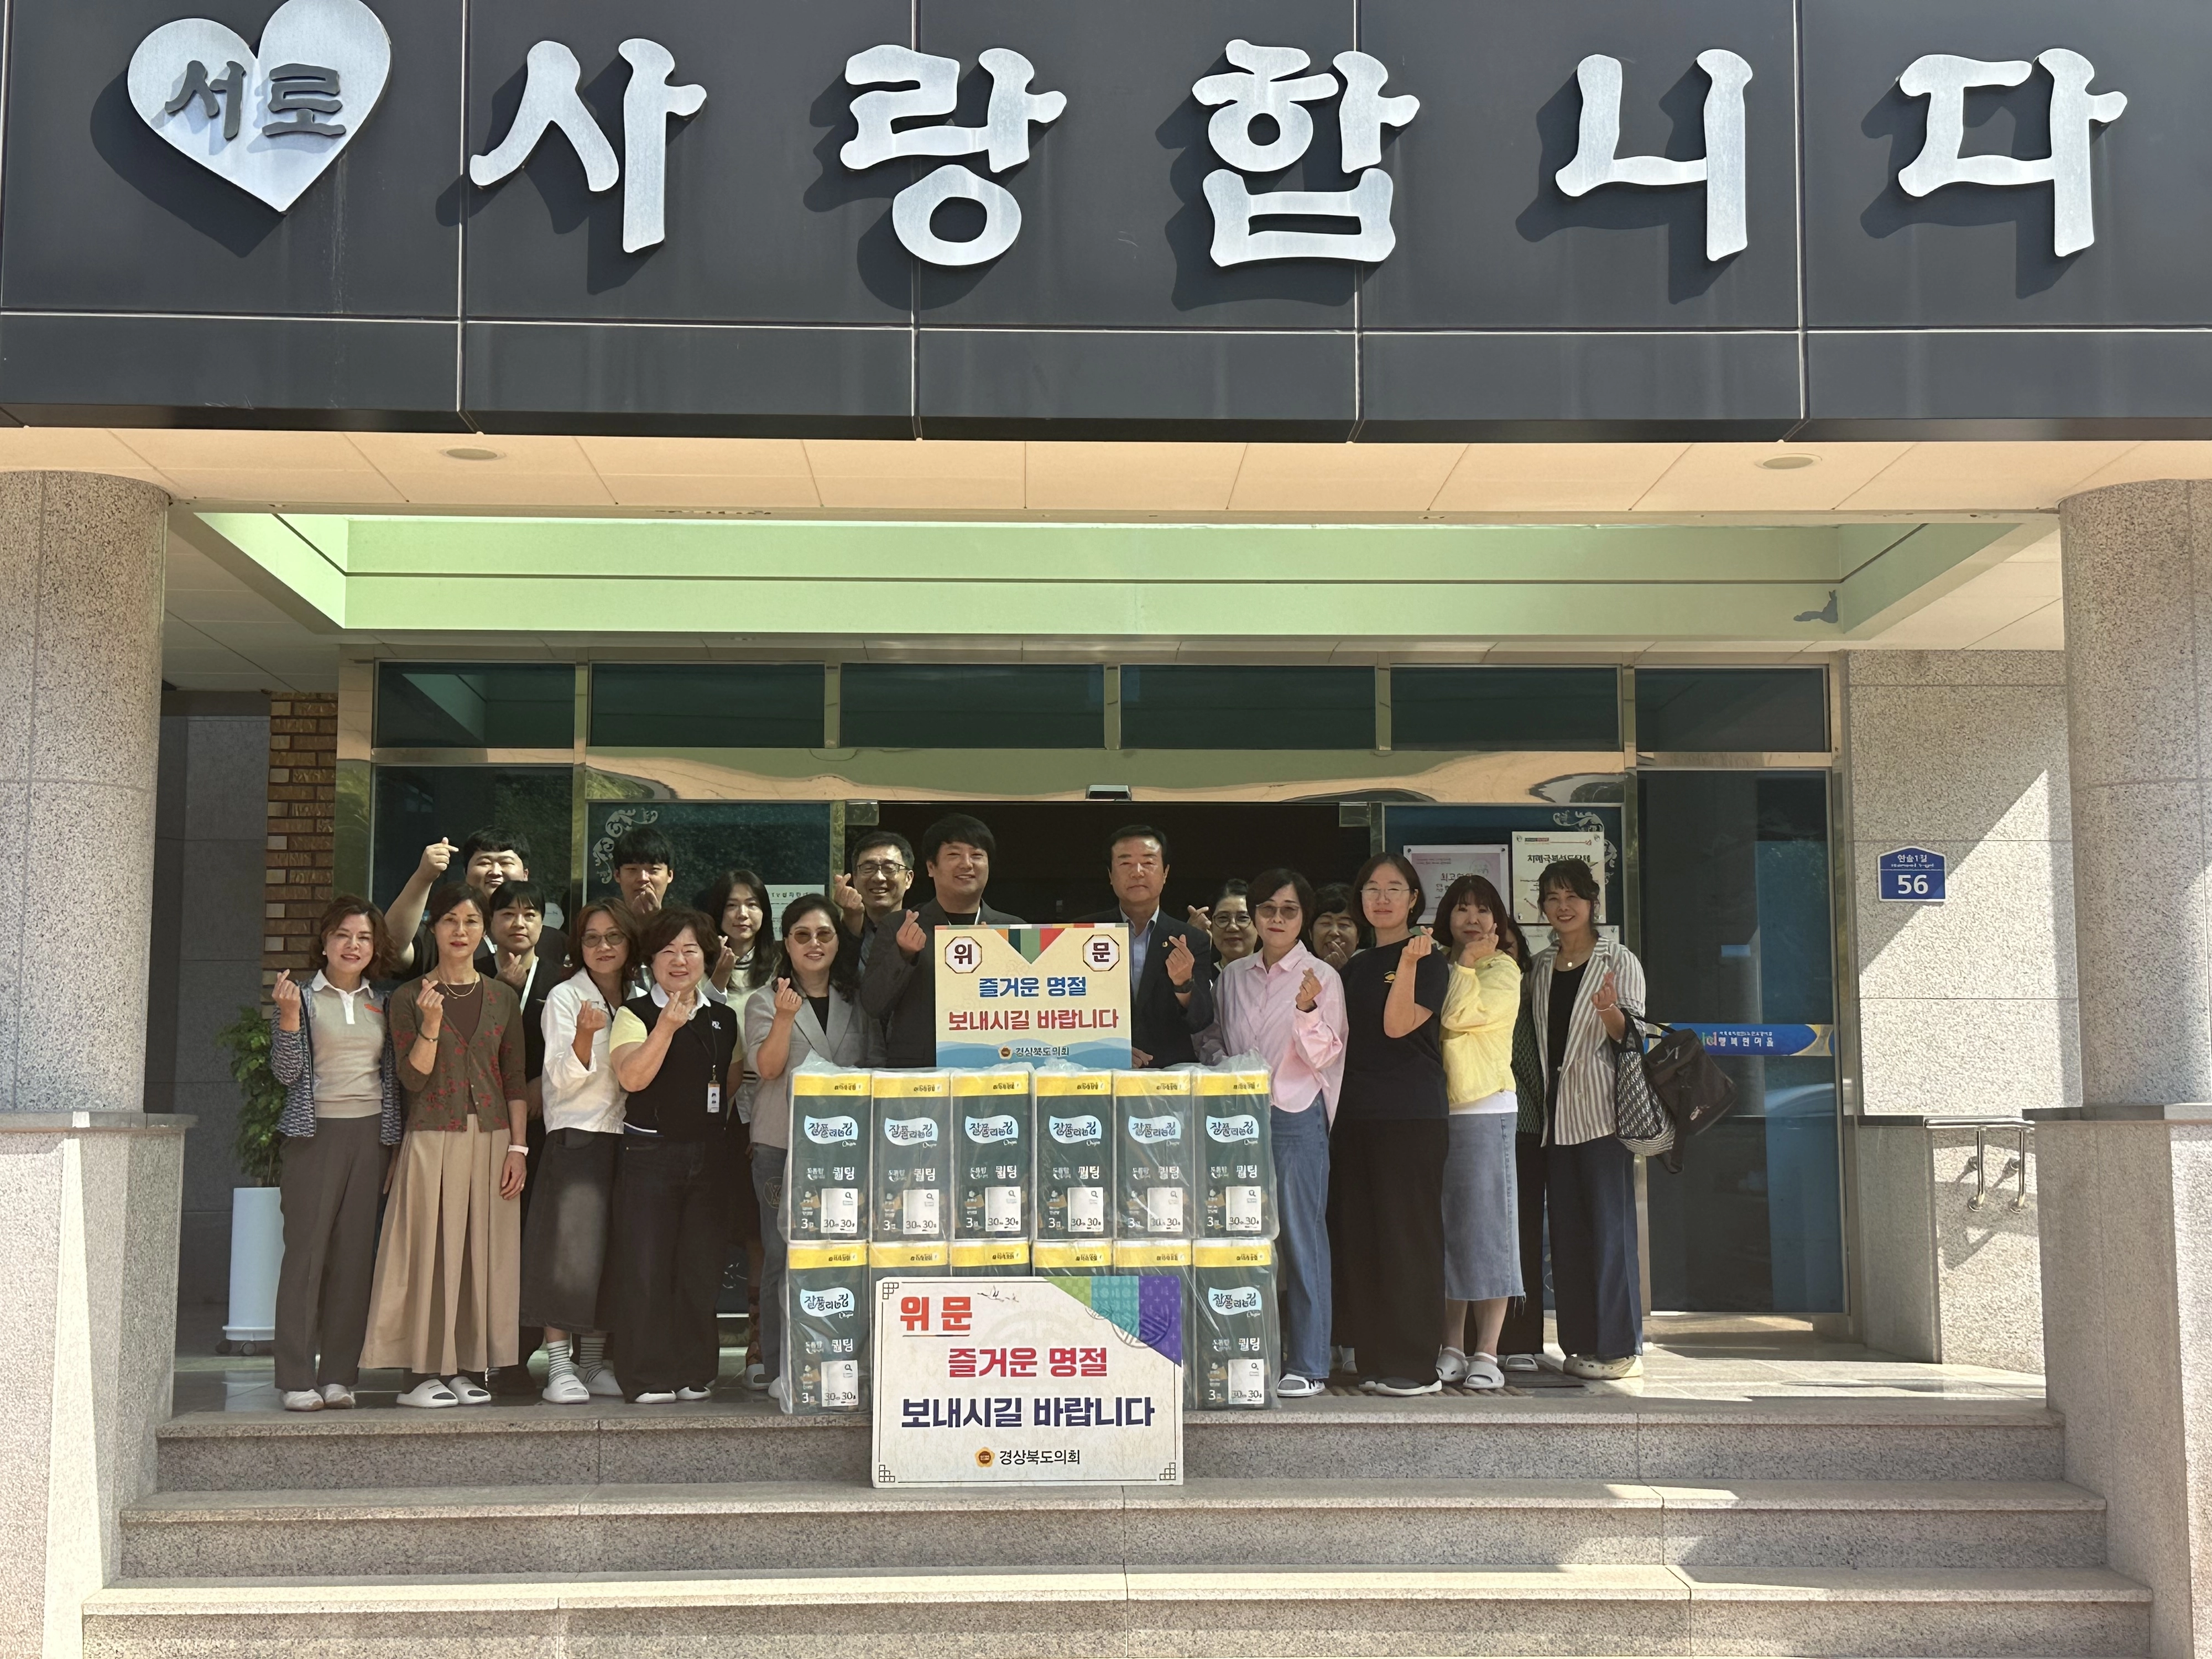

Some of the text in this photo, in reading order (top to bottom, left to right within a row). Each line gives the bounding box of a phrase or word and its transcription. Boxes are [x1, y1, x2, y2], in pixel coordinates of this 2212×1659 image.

[164, 37, 2127, 266] 서로 사랑합니다
[1898, 874, 1928, 894] 56
[954, 942, 1111, 965] 위 문
[979, 977, 1087, 997] 즐거운 명절
[948, 1009, 1119, 1031] 보내시길 바랍니다
[1015, 1046, 1070, 1057] 경상북도의회
[900, 1296, 972, 1331] 위 문
[948, 1347, 1107, 1378] 즐거운 명절
[901, 1397, 1155, 1428] 보내시길 바랍니다
[999, 1449, 1081, 1465] 경상북도의회
